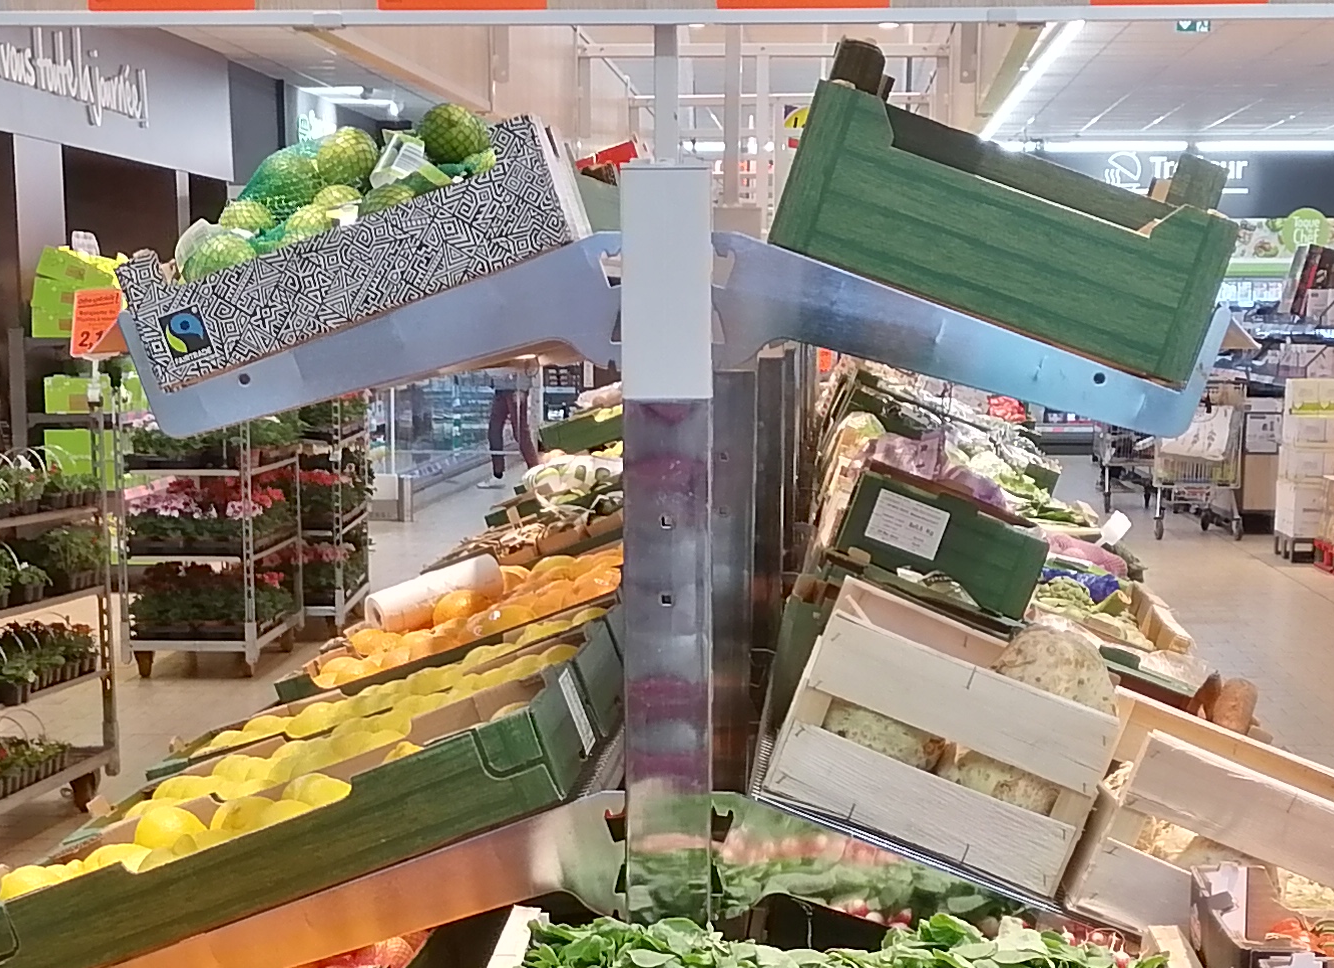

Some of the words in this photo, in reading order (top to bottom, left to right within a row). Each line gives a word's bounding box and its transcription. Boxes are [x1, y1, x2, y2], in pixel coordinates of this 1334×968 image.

[33, 27, 79, 95] toute
[1293, 216, 1320, 230] Toque
[1293, 228, 1319, 245] Chef
[174, 345, 213, 367] FAIRTRADE
